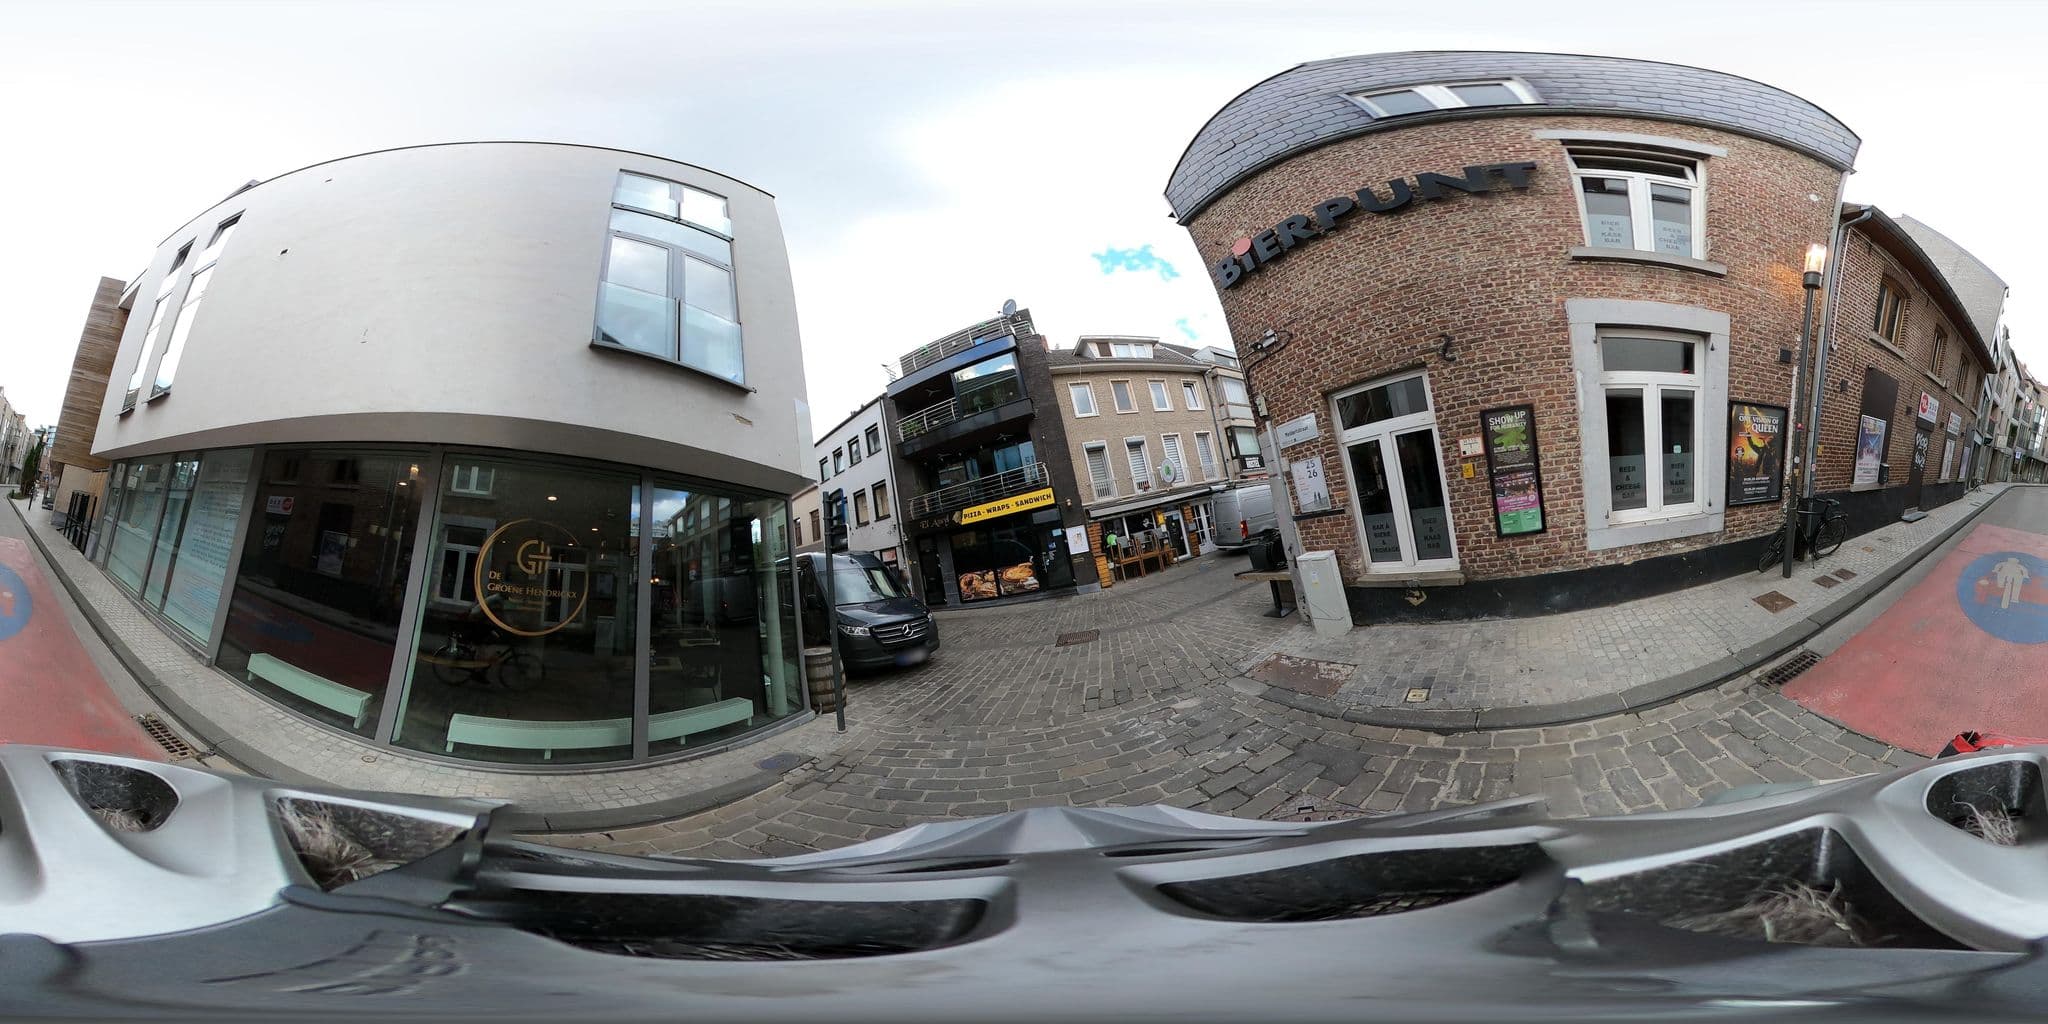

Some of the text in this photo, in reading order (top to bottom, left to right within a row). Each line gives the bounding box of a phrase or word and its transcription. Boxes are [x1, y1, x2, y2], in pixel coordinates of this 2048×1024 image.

[1489, 411, 1526, 426] SHOW UP
[1751, 423, 1778, 433] QUEEN
[1306, 461, 1316, 469] 25
[1618, 465, 1636, 473] BEER
[1307, 470, 1318, 479] 26
[963, 511, 982, 519] PIZZA
[986, 504, 1010, 514] WRAPS
[1015, 493, 1052, 507] SANDWICH
